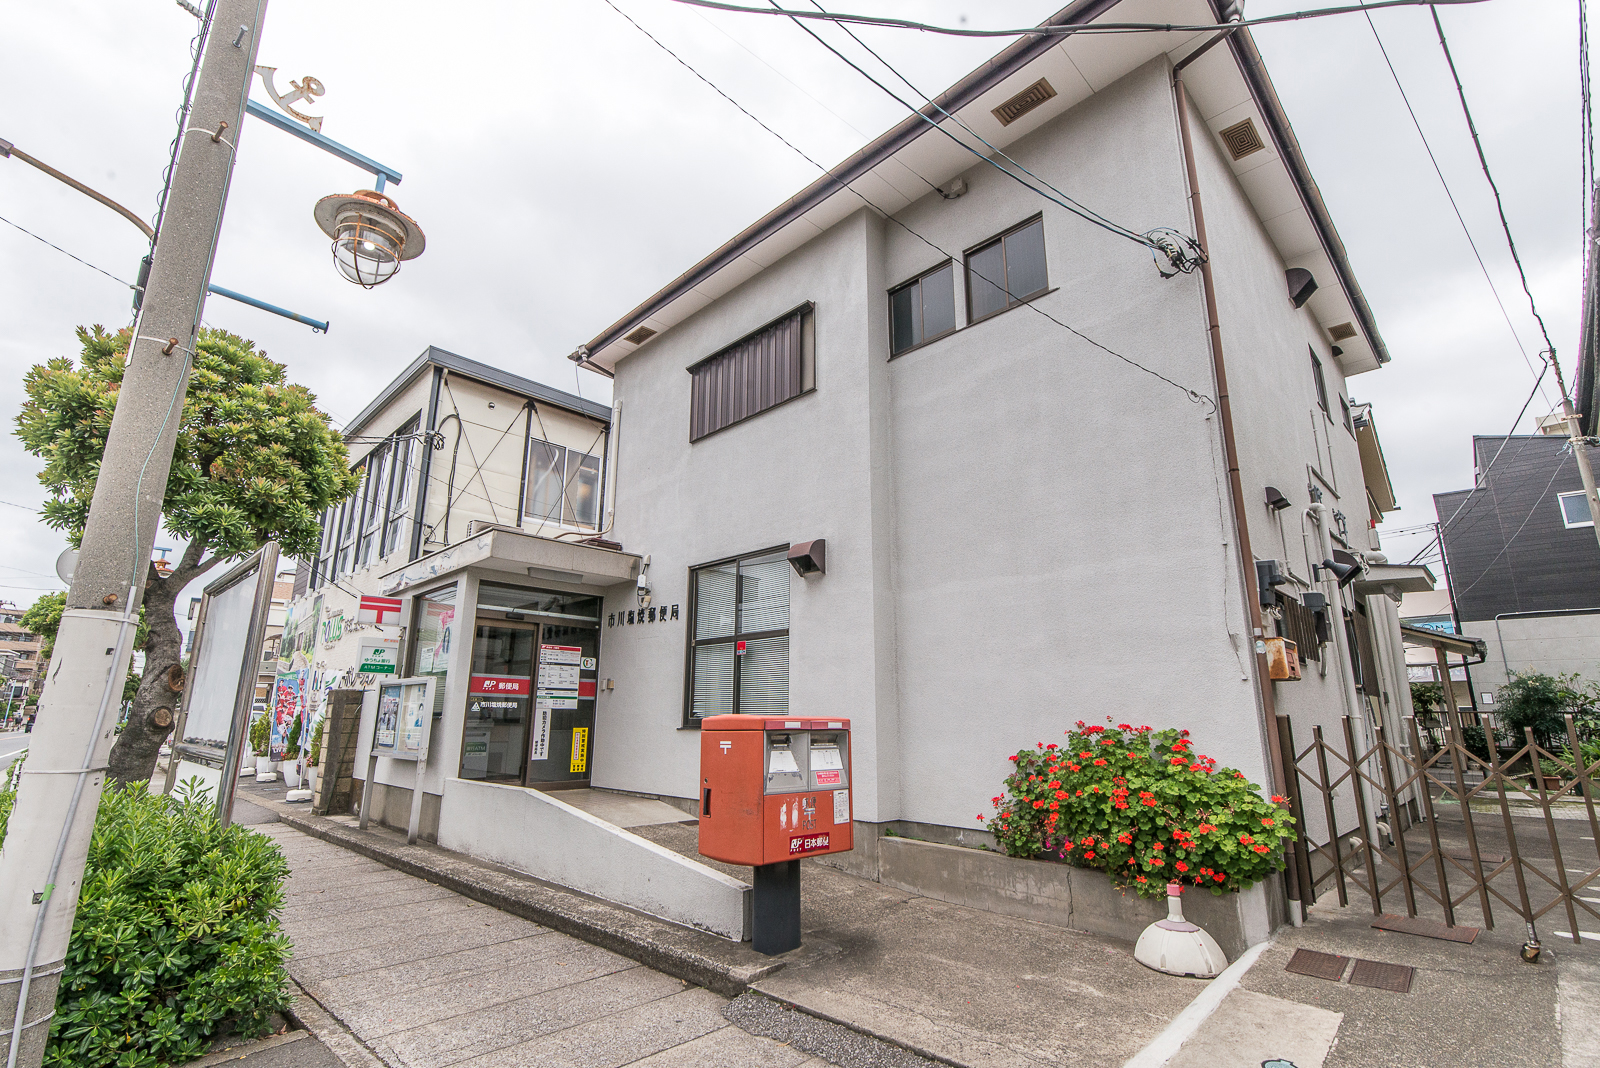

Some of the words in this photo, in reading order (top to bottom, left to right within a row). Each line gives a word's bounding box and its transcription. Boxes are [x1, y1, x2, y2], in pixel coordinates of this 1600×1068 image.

[607, 604, 679, 629] 市川塩焼郵便局
[498, 682, 519, 691] 郵便局
[802, 819, 817, 830] POST
